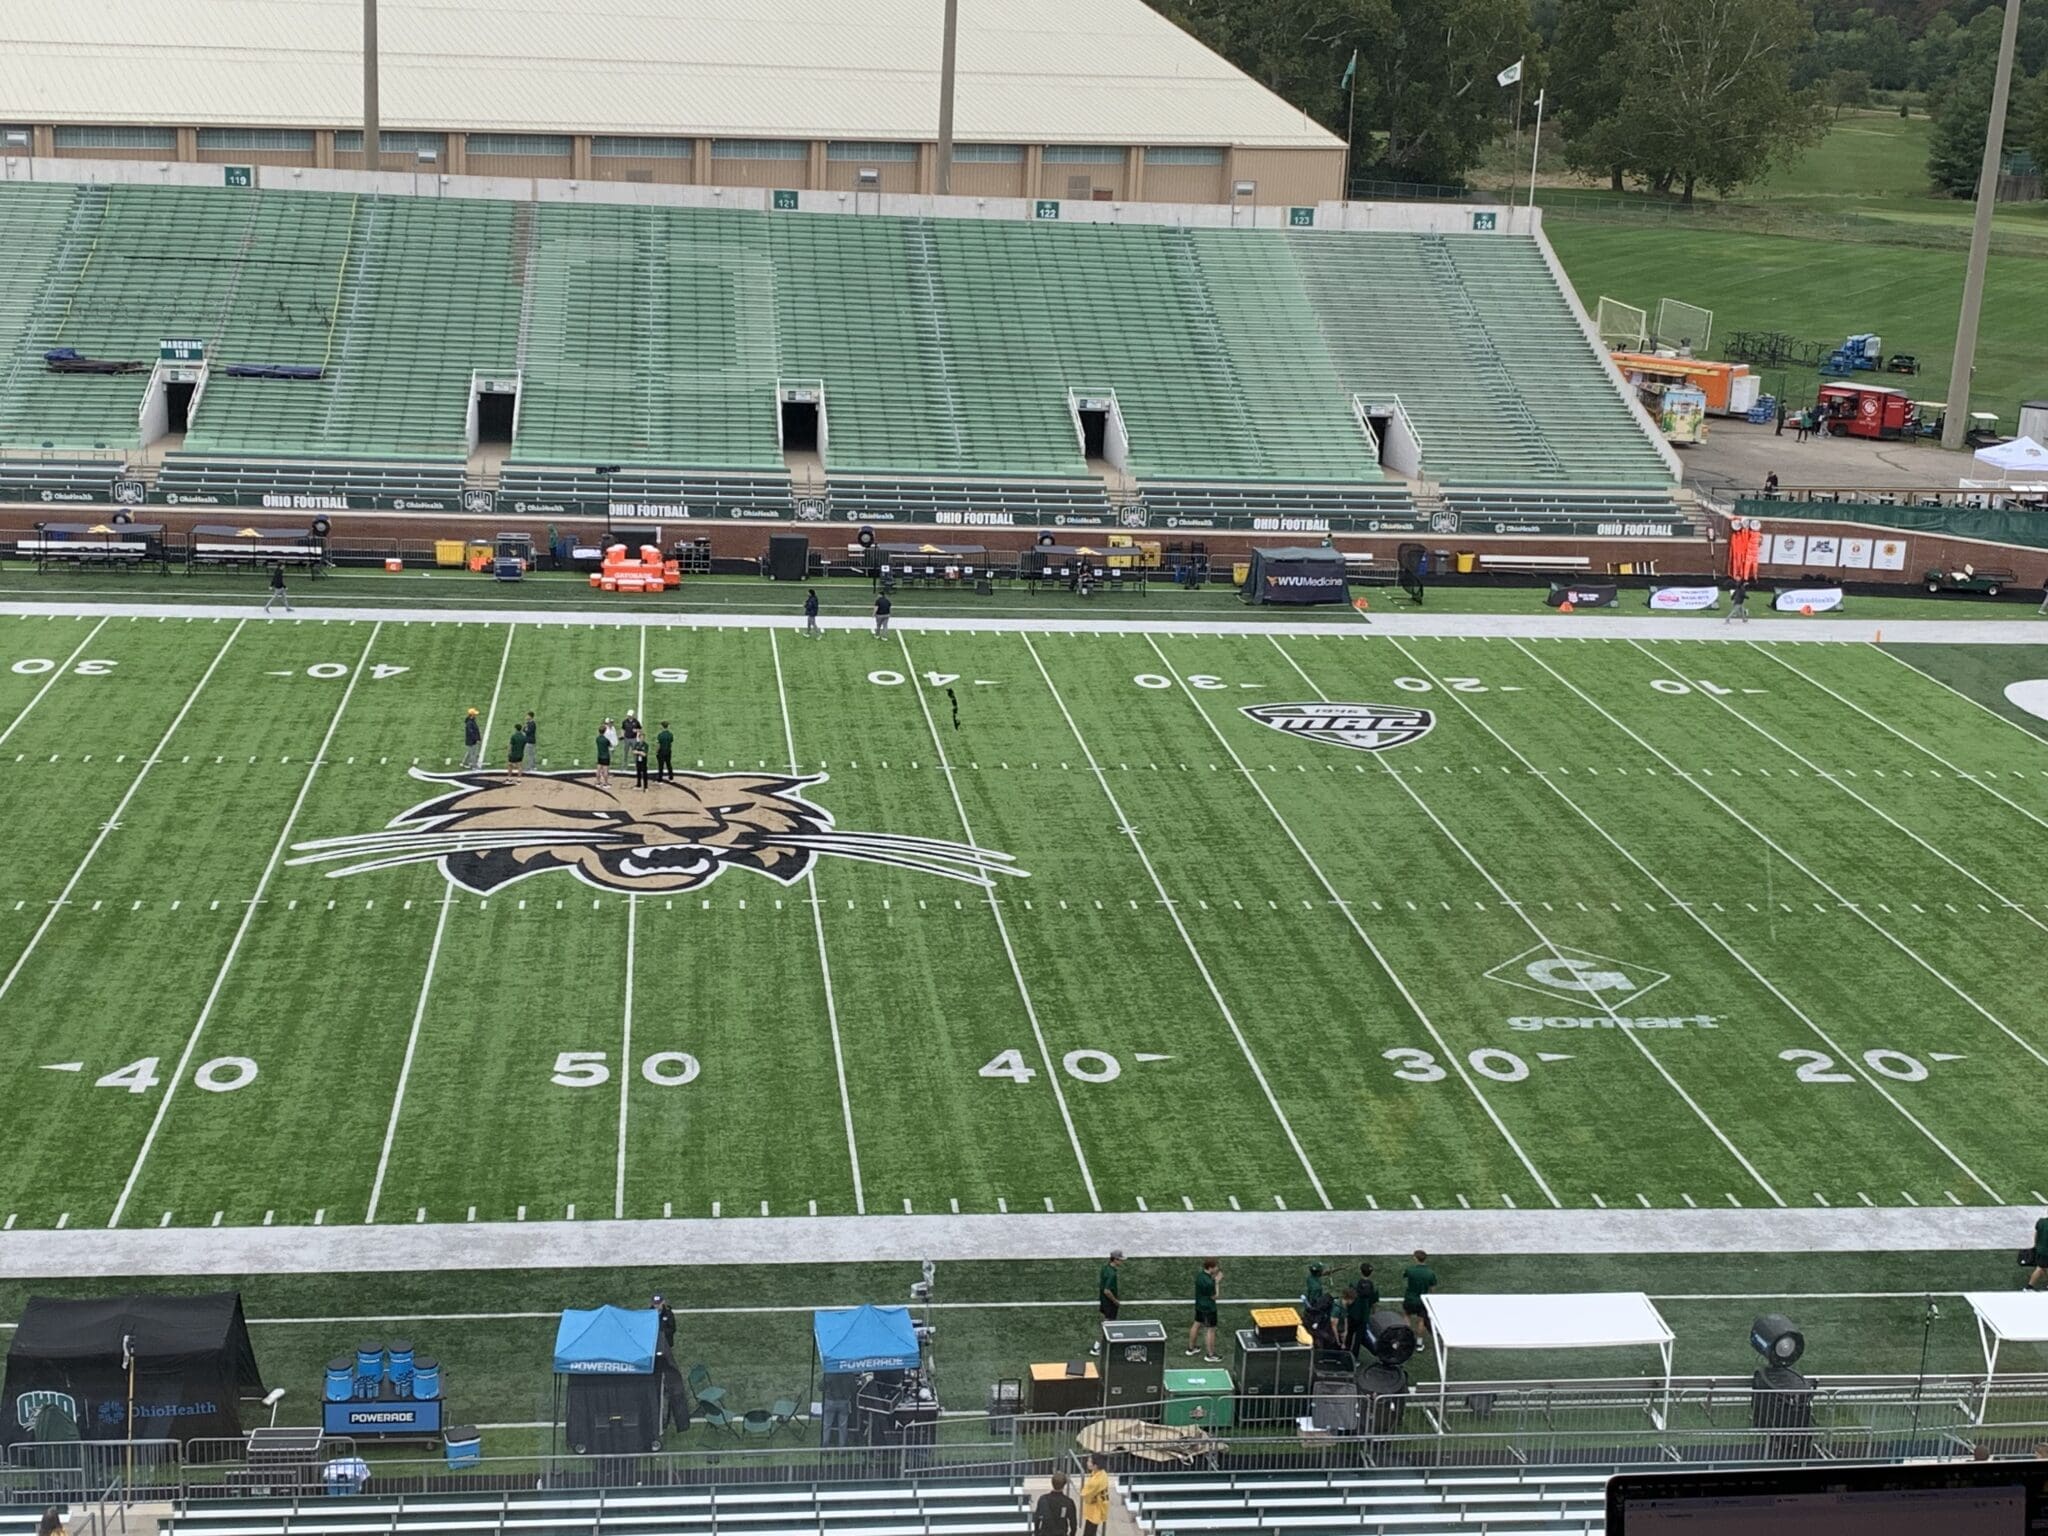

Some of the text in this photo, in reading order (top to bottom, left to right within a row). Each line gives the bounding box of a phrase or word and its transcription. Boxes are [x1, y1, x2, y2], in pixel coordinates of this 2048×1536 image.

[229, 176, 247, 185] 119
[778, 199, 795, 208] 121
[1039, 209, 1057, 218] 122
[1294, 216, 1310, 225] 123
[262, 494, 349, 509] OHIO FOOTBALL
[609, 503, 690, 517] OHIO FOOTBALL
[935, 511, 1015, 525] OHIO FOOTBALL
[1253, 517, 1330, 532] OHIO FOOTBALL
[1597, 523, 1673, 536] OHIO FOOTBALL
[570, 1361, 636, 1371] POWERADE
[839, 1358, 905, 1369] POWERADE
[131, 1401, 217, 1418] OhioHealth
[351, 1412, 414, 1423] POWERADE
